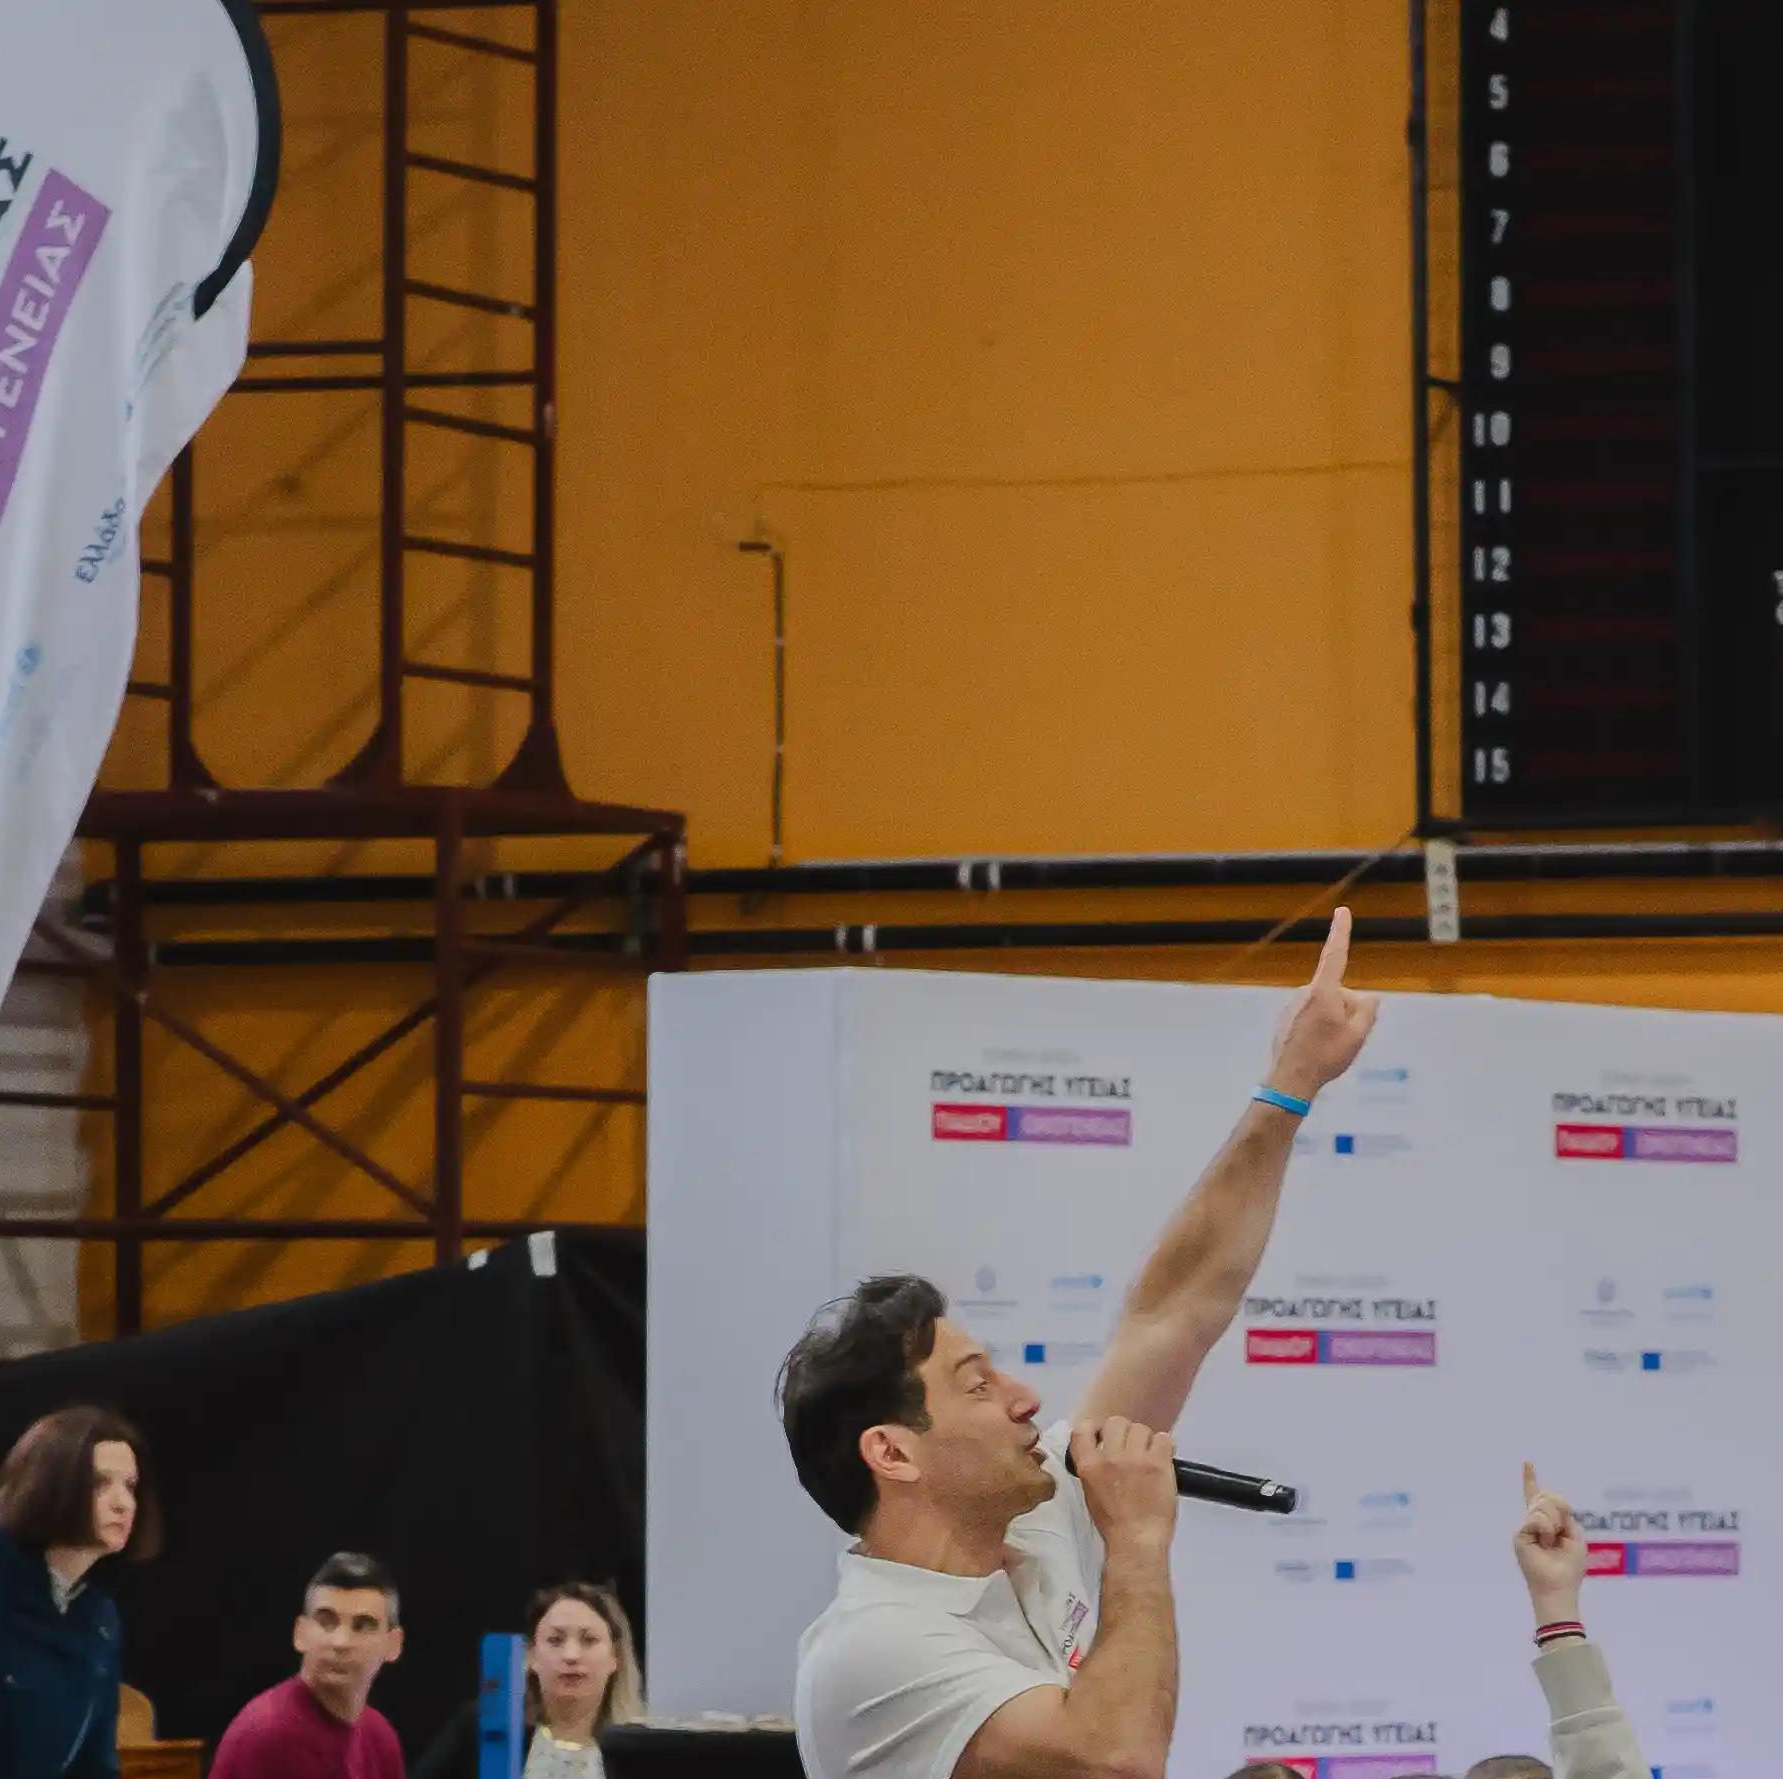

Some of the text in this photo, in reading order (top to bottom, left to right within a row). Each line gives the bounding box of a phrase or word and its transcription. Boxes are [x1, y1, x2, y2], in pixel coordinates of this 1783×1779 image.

[1489, 7, 1509, 41] 4
[1489, 74, 1509, 109] 5
[1490, 209, 1509, 243] 7
[1473, 411, 1510, 446] 10
[1474, 479, 1511, 514] 11
[1473, 546, 1511, 582] 12
[1474, 612, 1511, 649] 13
[1474, 681, 1510, 716] 14
[1475, 747, 1510, 782] 15
